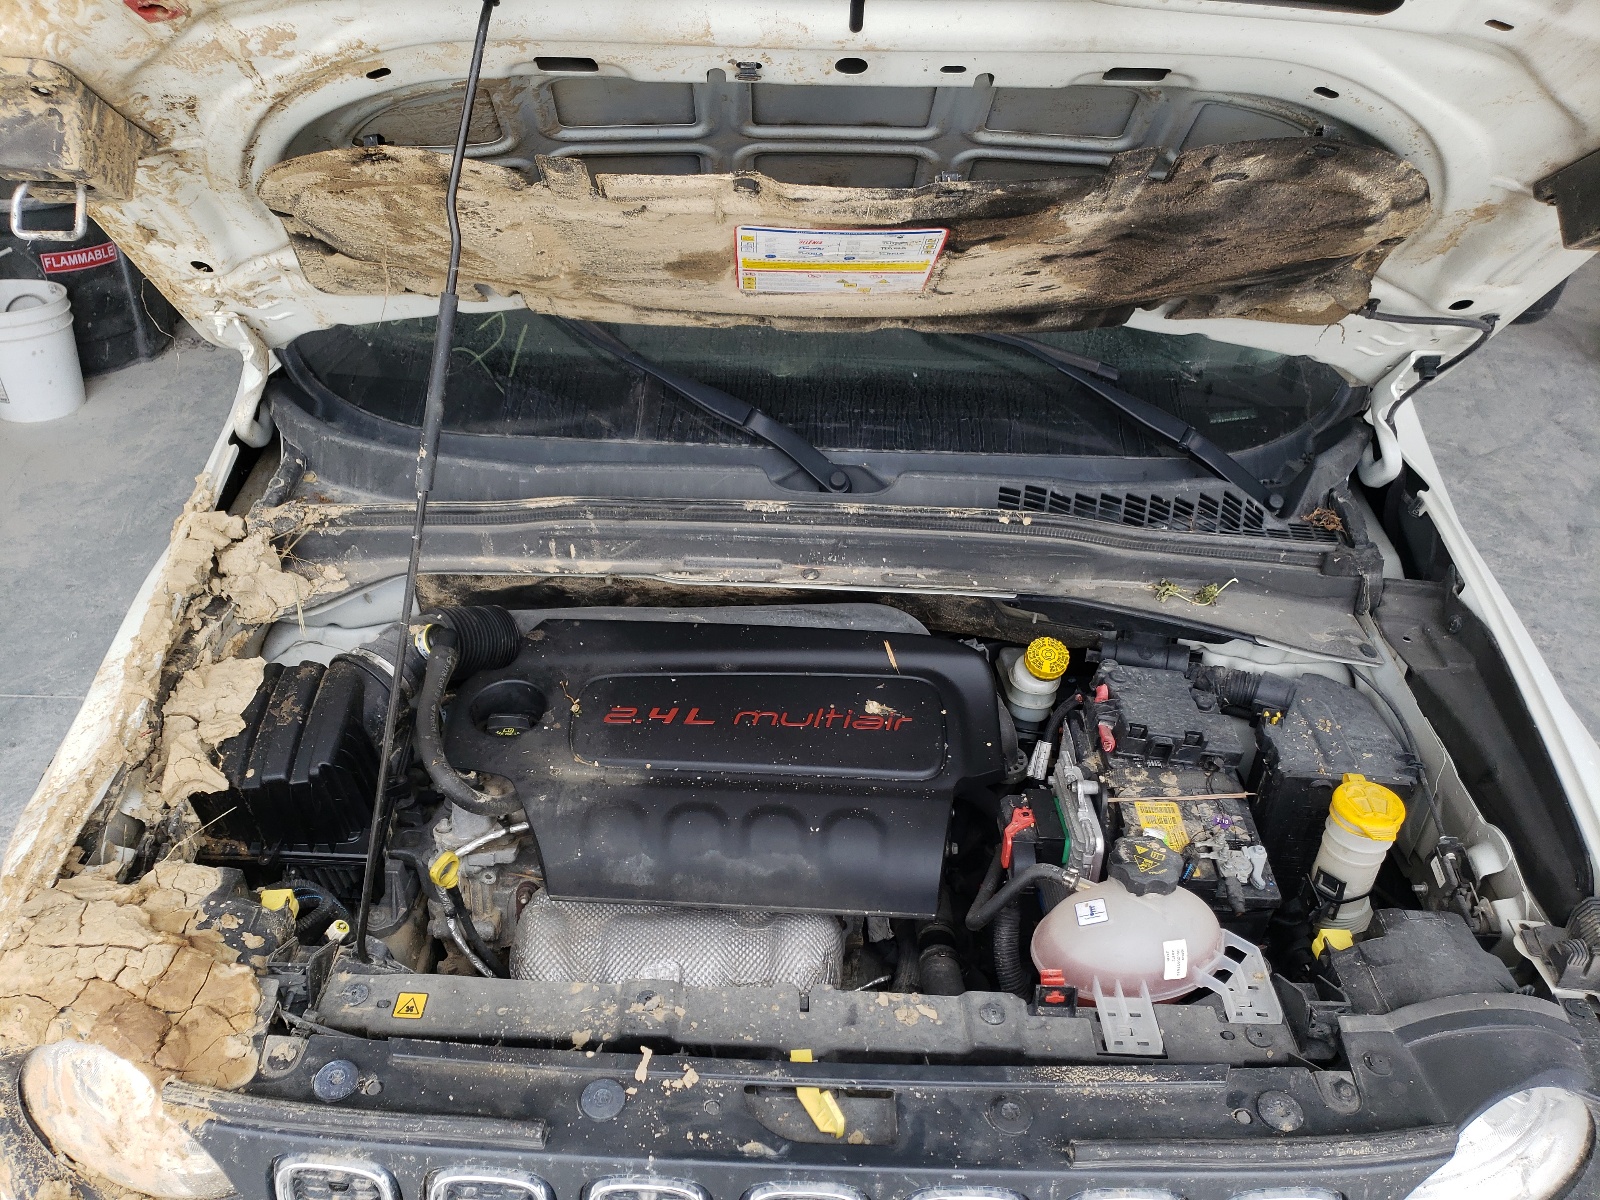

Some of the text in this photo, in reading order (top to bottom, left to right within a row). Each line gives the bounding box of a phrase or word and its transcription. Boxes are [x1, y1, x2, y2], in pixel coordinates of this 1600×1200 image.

[43, 245, 116, 269] FLAMMABLE
[603, 707, 913, 731] 2.4L multiair
